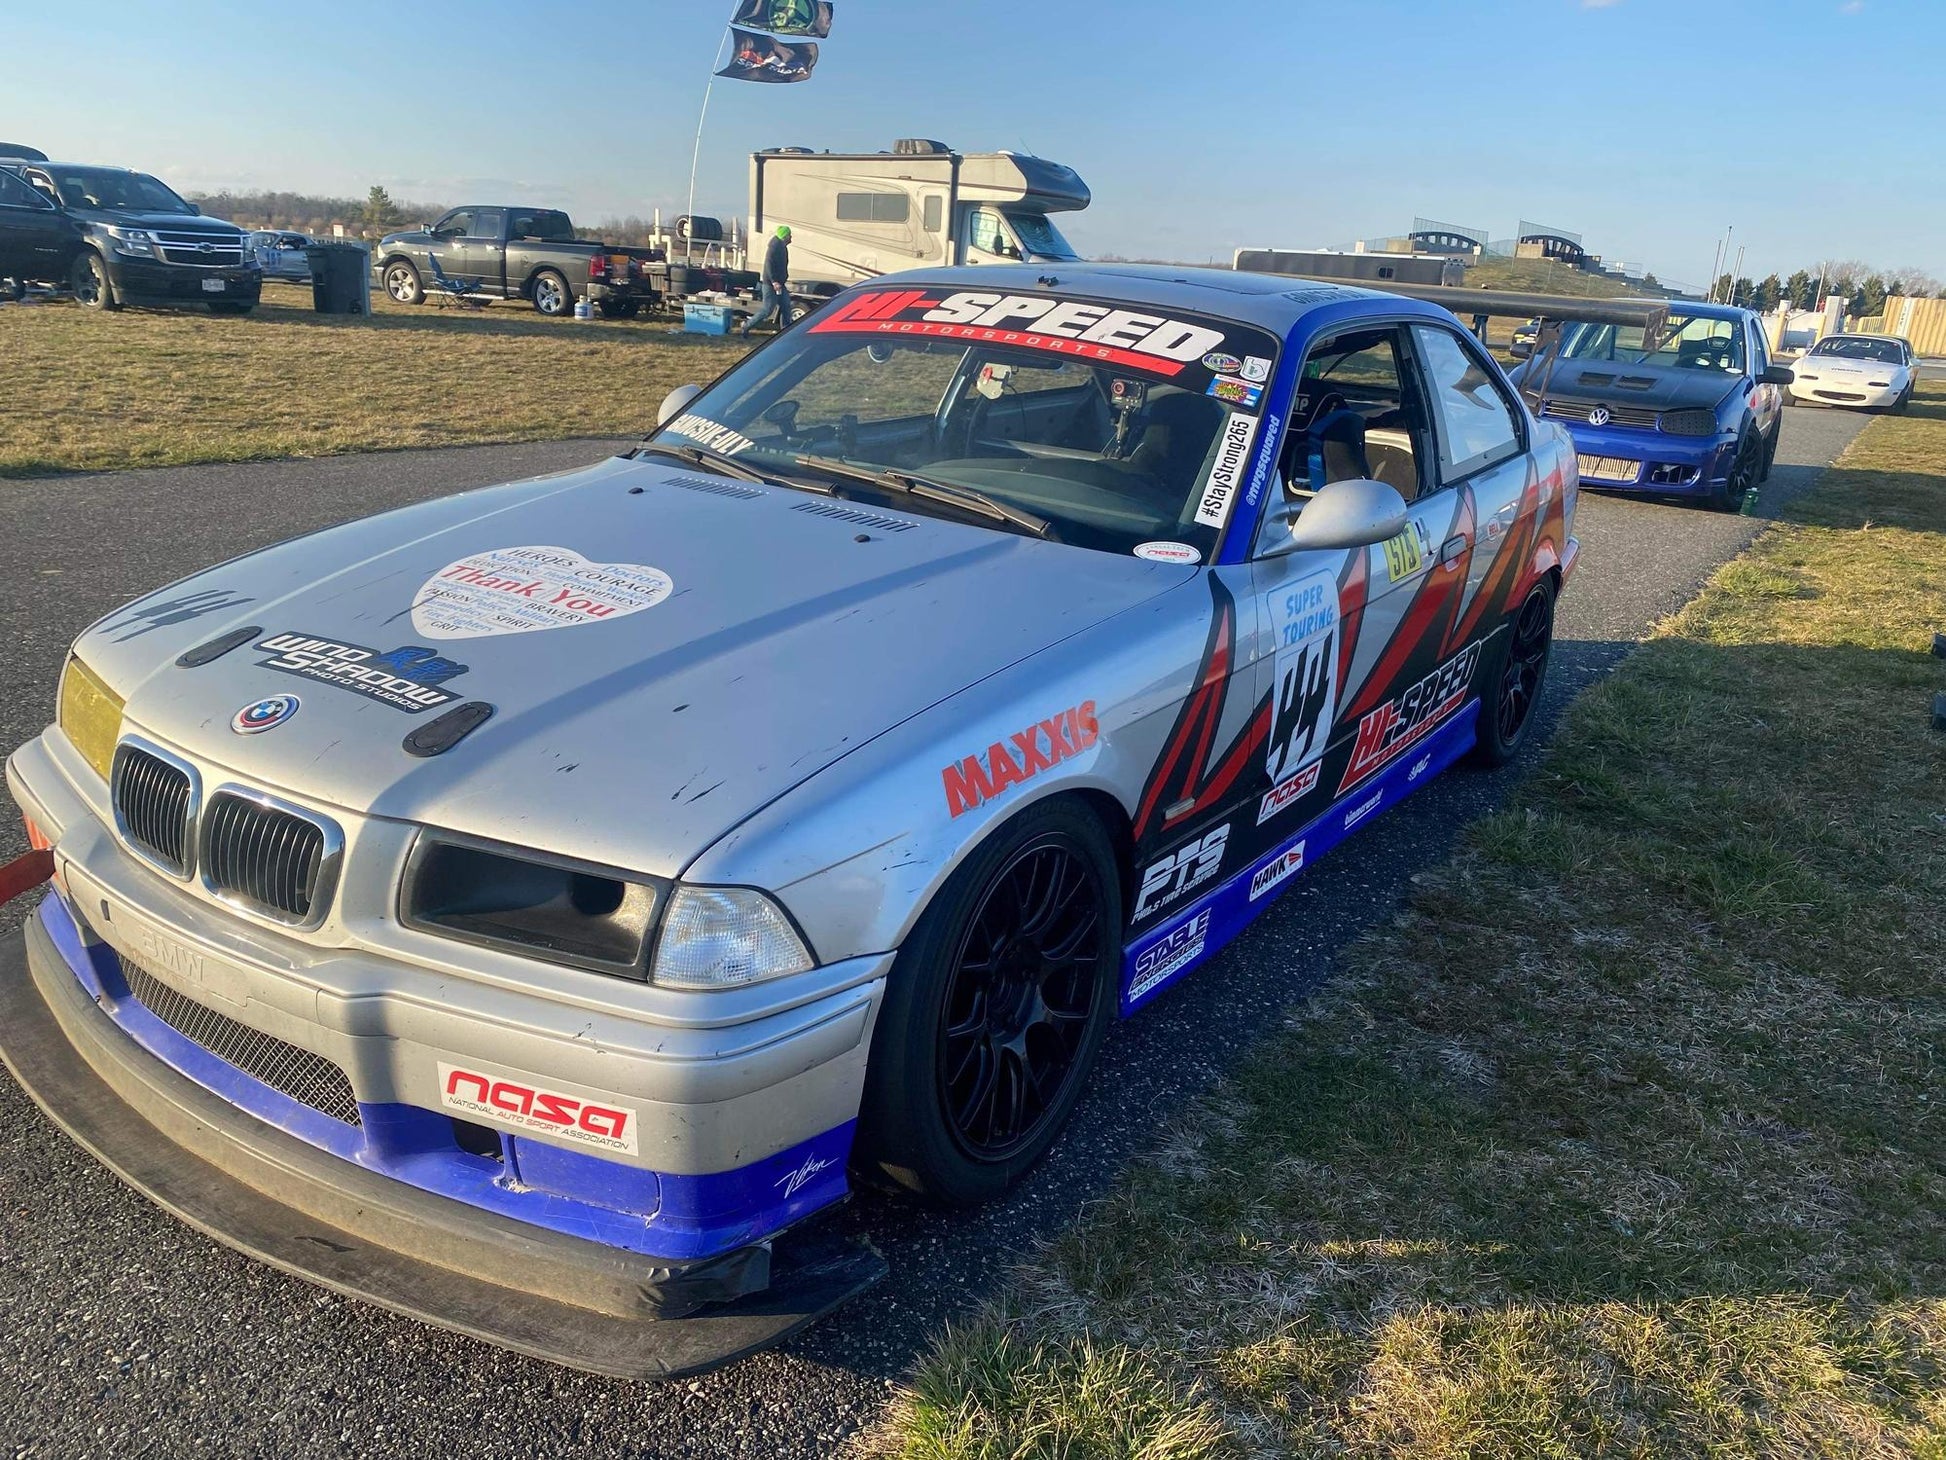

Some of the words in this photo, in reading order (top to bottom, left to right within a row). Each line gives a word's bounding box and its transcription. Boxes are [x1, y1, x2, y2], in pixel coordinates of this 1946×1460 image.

[826, 291, 1226, 362] HI-SPEED
[878, 321, 1113, 359] MOTORSPORTS
[1201, 420, 1249, 518] #StayStrong265
[1245, 414, 1280, 506] @mrgsquared
[507, 549, 577, 566] HEROES
[602, 566, 664, 585] Doctors
[440, 565, 543, 596] Thank
[548, 589, 616, 616] You
[573, 570, 661, 595] COURAGE
[1286, 584, 1324, 618] SUPER
[429, 620, 463, 631] GRIT
[492, 615, 537, 628] SPIRIT
[524, 602, 585, 621] BRAVERY
[1283, 604, 1334, 648] TOURING
[261, 634, 373, 664] WIND
[267, 652, 449, 706] SHADOW
[300, 667, 354, 686] PHOTO
[354, 682, 424, 711] STUDIOS
[1268, 629, 1334, 782] 44
[1352, 640, 1482, 773] HI-SPEED
[942, 700, 1099, 819] MAXXIS
[1261, 764, 1318, 814] nasa
[1135, 823, 1231, 914] PTS
[1252, 853, 1289, 894] HAWK
[447, 1070, 628, 1139] nasa
[448, 1096, 494, 1116] NATIONAL
[496, 1112, 524, 1124] AUTO
[526, 1118, 561, 1133] SPORT
[561, 1128, 630, 1151] ASSOCIATION
